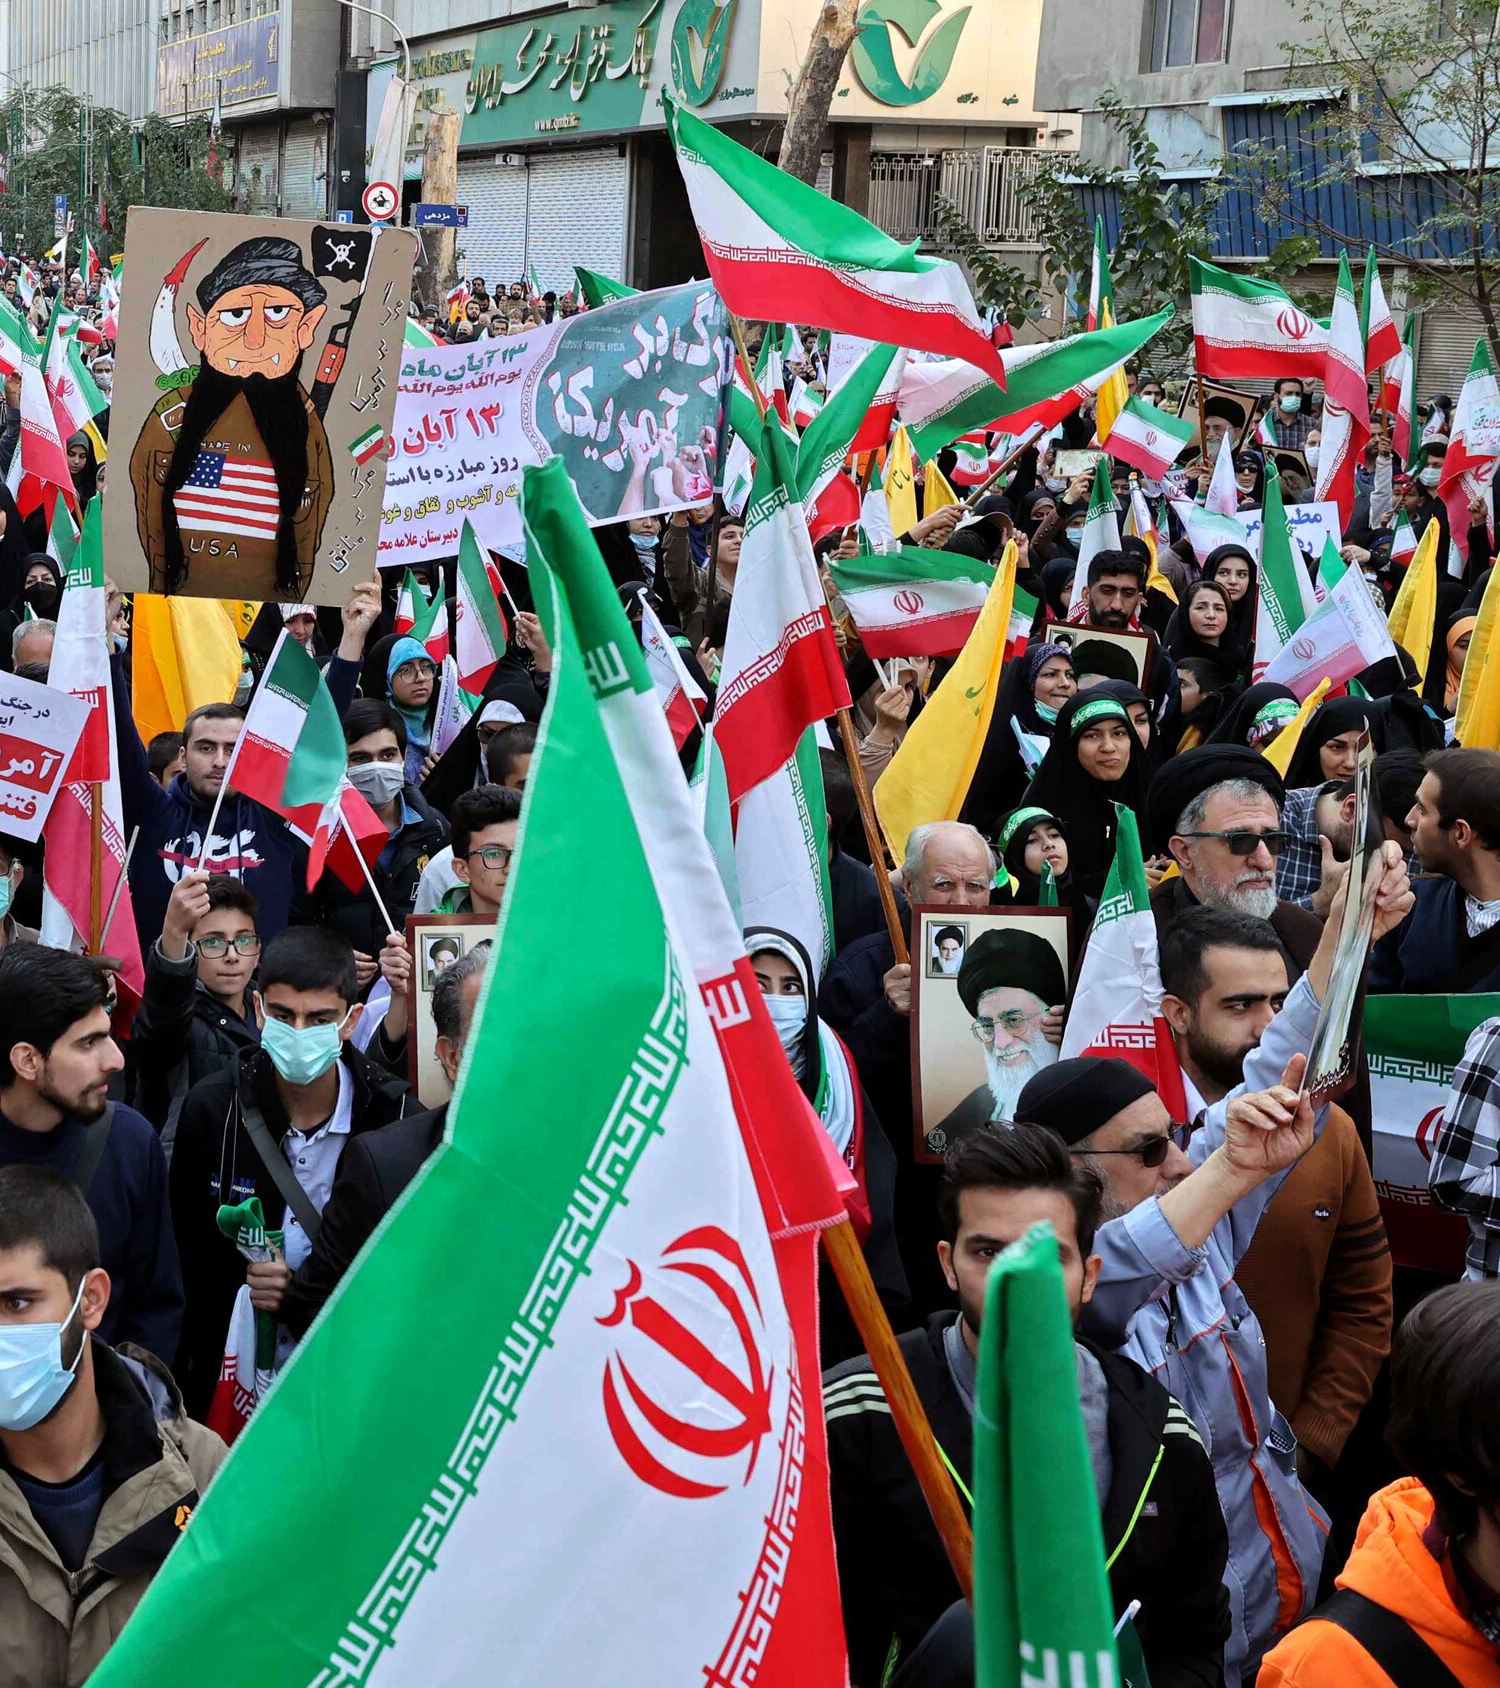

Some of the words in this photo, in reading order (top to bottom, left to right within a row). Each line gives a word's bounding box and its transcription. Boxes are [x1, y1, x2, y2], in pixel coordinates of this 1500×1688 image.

[401, 358, 442, 379] ماه
[445, 348, 500, 381] آبان
[403, 407, 458, 455] آبان
[200, 441, 231, 451] MADE
[434, 459, 486, 483] مبارزه
[491, 456, 519, 475] روز
[455, 485, 493, 511] آشوب
[189, 537, 238, 559] USA
[0, 695, 33, 711] جنگ
